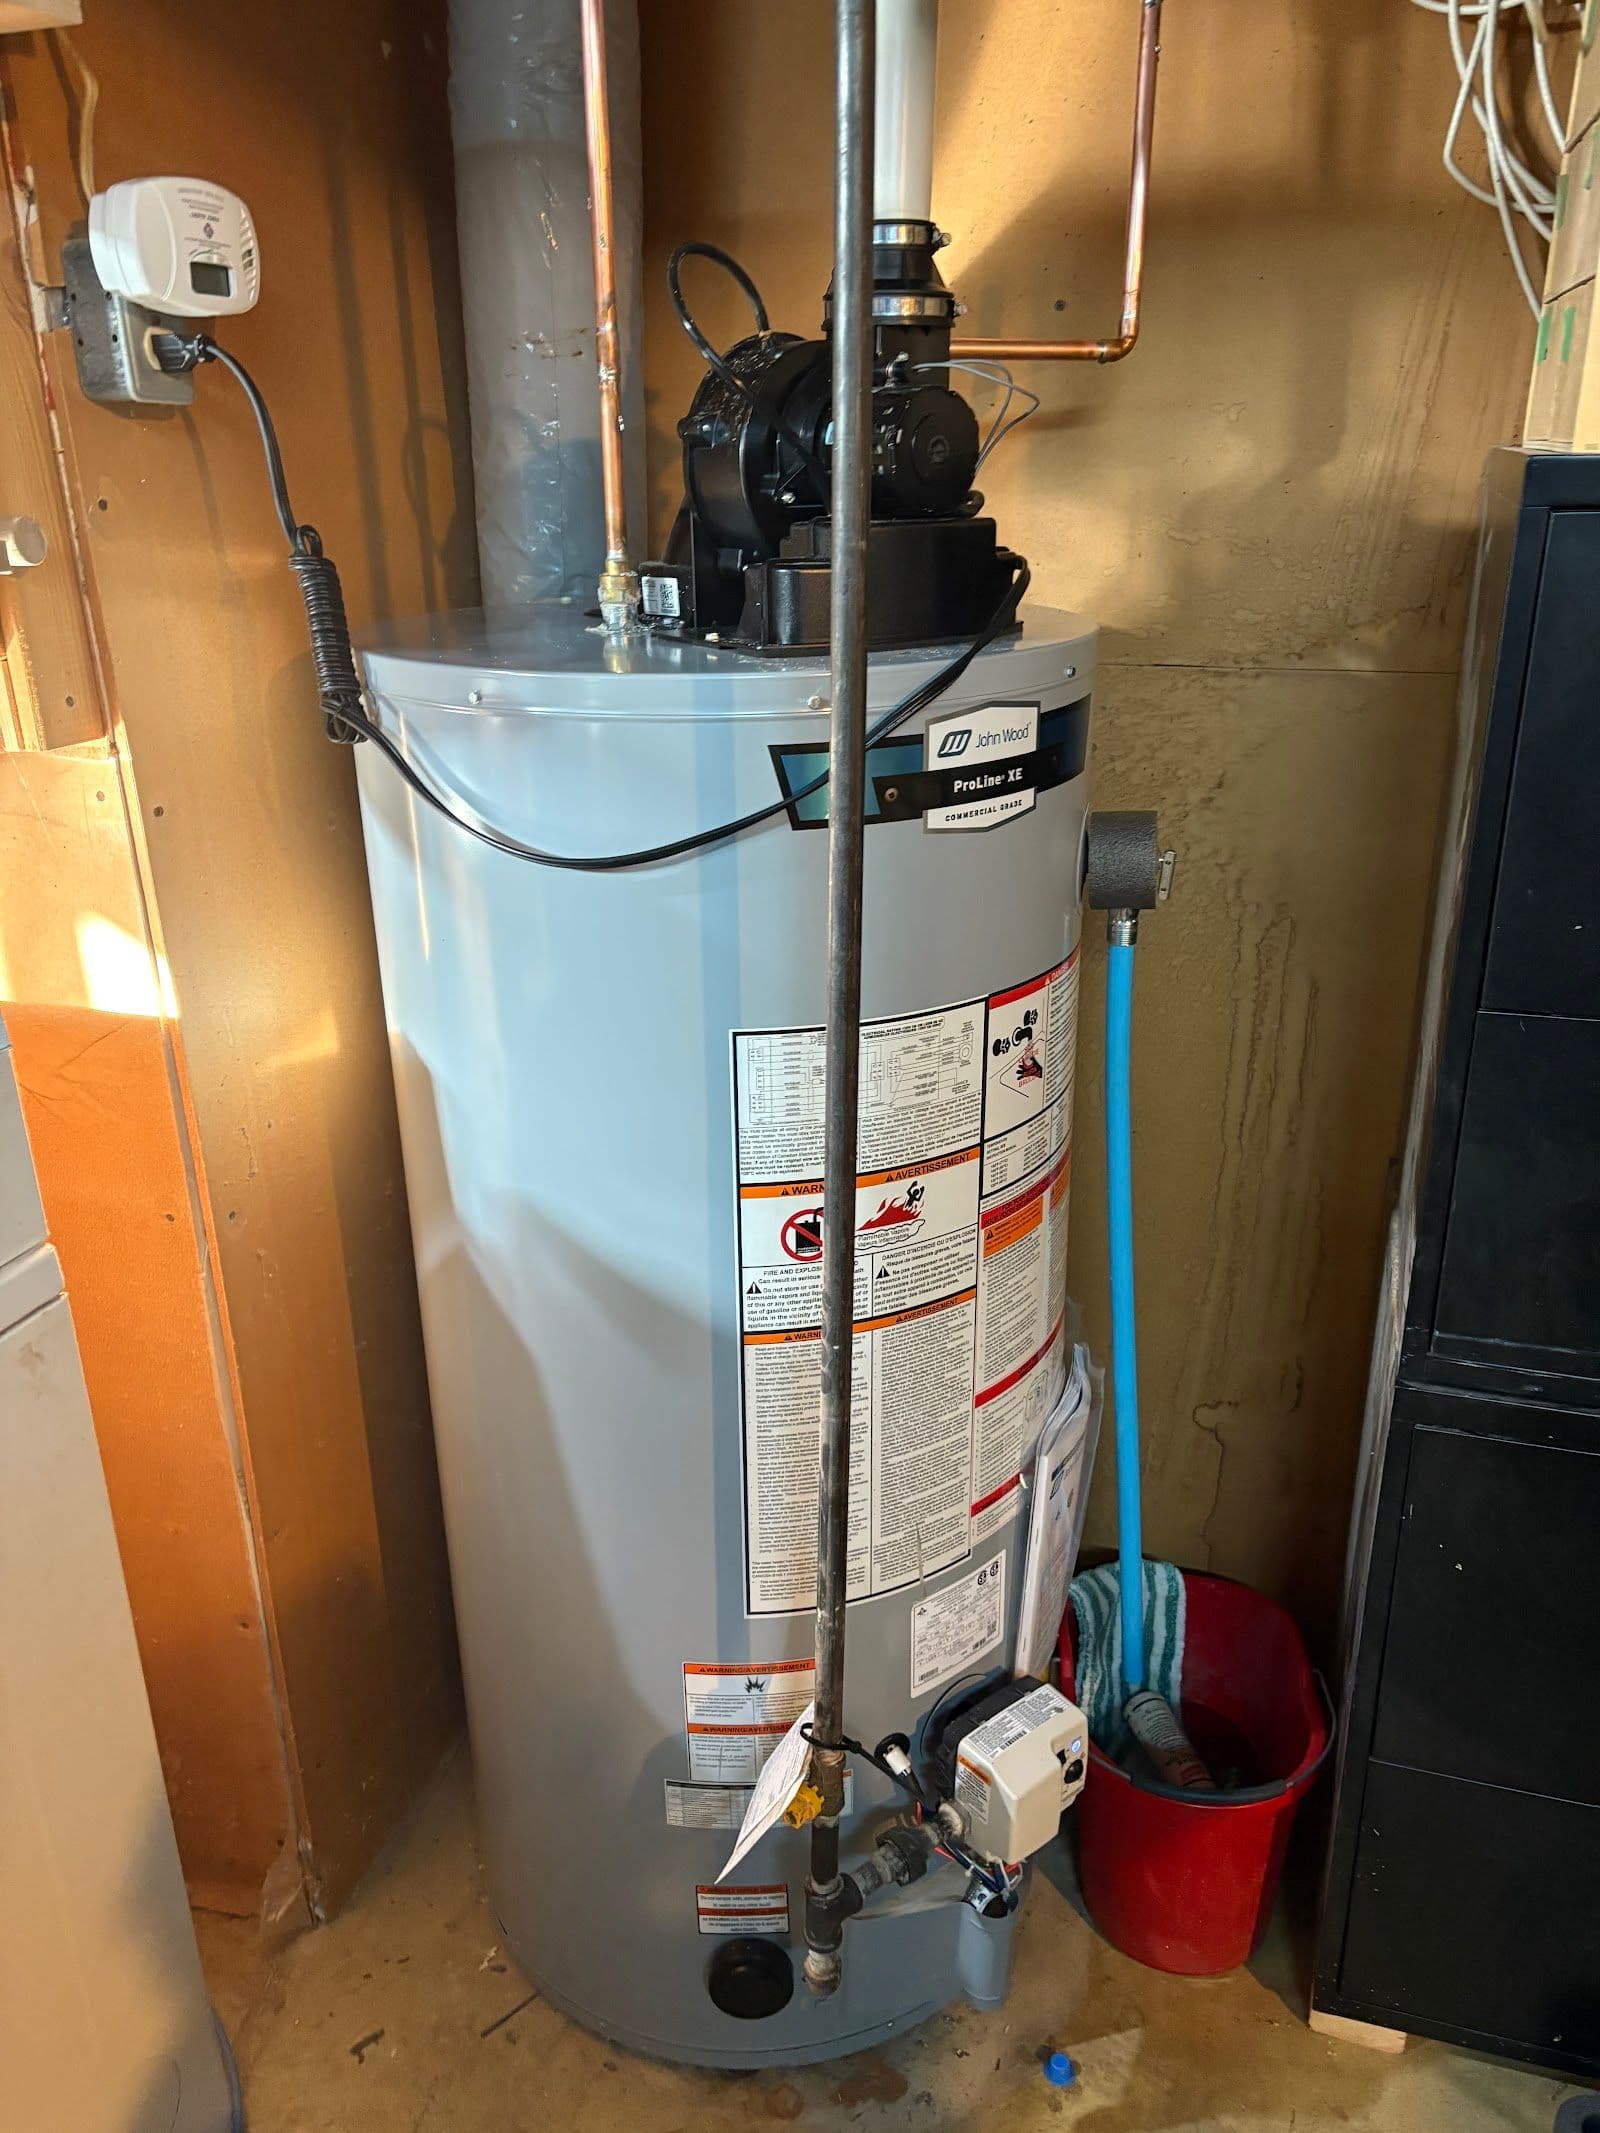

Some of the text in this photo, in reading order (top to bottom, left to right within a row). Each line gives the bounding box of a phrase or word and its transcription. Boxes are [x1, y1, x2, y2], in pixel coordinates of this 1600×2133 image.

[976, 723, 1029, 748] John Wood
[1008, 768, 1023, 782] XE
[945, 800, 1022, 821] COMMERCIAL GRADE
[896, 1152, 971, 1180] AVERTISSEMENT
[792, 1184, 824, 1194] WARN
[882, 1250, 906, 1261] DANGER
[795, 1266, 822, 1274] EXPLOS
[903, 1298, 958, 1320] AVERTISSEMENT
[794, 1331, 820, 1340] WARNI
[707, 1663, 810, 1673] WARNING/AVERTISSEMENT
